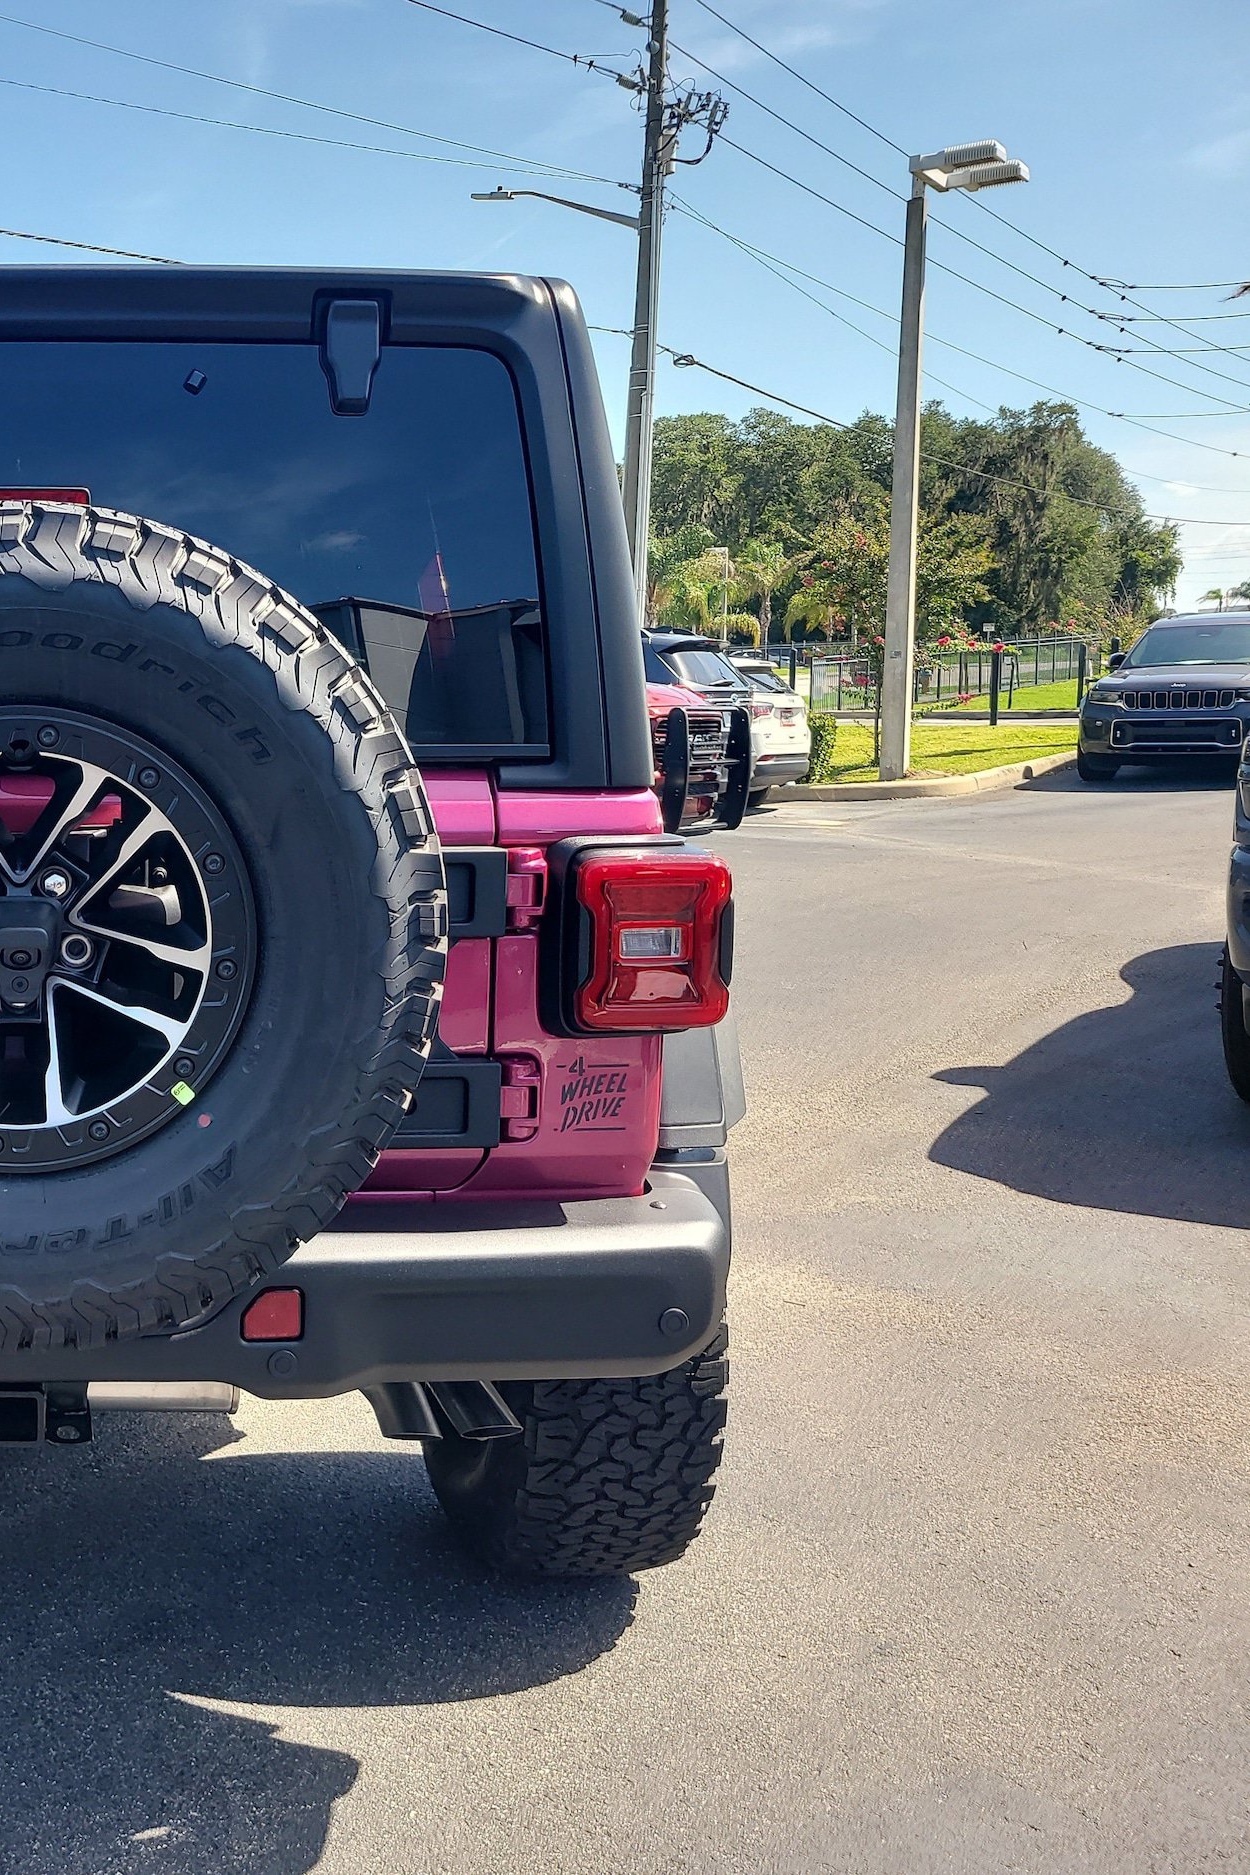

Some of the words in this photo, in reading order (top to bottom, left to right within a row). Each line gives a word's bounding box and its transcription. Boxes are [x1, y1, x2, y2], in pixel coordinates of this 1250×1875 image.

[569, 1056, 585, 1076] 4
[561, 1073, 627, 1105] WHEEL
[560, 1097, 626, 1133] DRIVE
